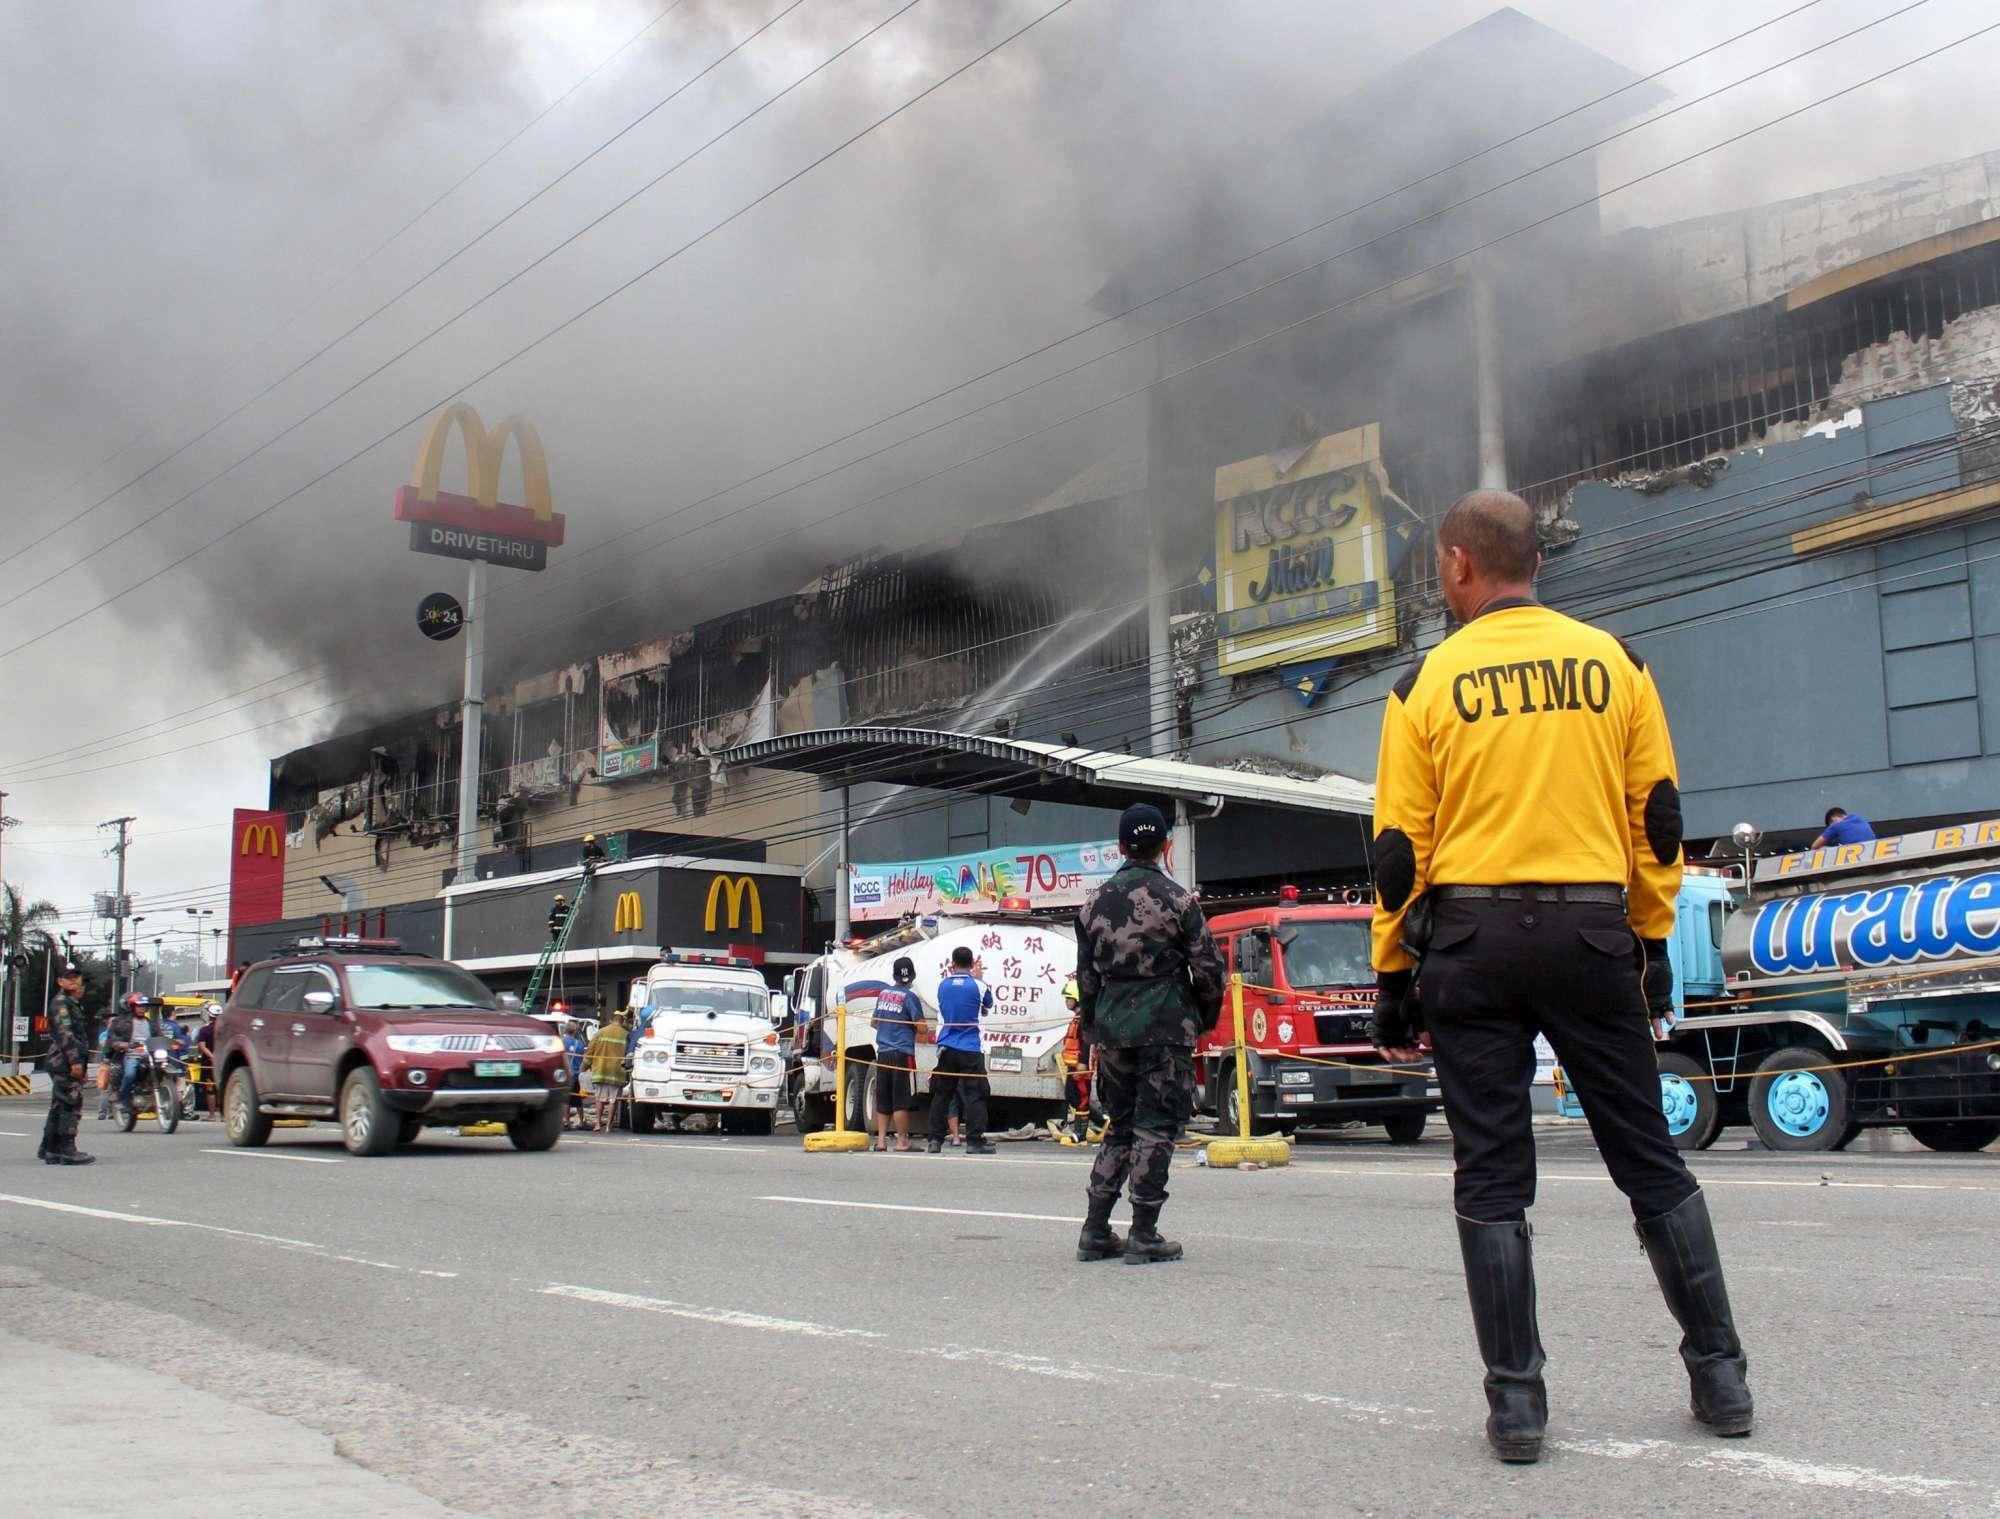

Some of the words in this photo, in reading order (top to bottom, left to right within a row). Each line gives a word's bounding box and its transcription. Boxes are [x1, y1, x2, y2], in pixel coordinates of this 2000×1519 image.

[431, 528, 535, 559] DRIVETHRU
[442, 610, 458, 624] 24
[1452, 657, 1611, 723] CTTMO
[1779, 836, 1903, 875] FIRE
[853, 881, 880, 894] NCCC
[888, 866, 935, 899] Holiday
[934, 862, 1017, 904] SALE
[1015, 853, 1057, 893] 70
[1058, 873, 1082, 890] OFF
[993, 1004, 1027, 1016] 1989
